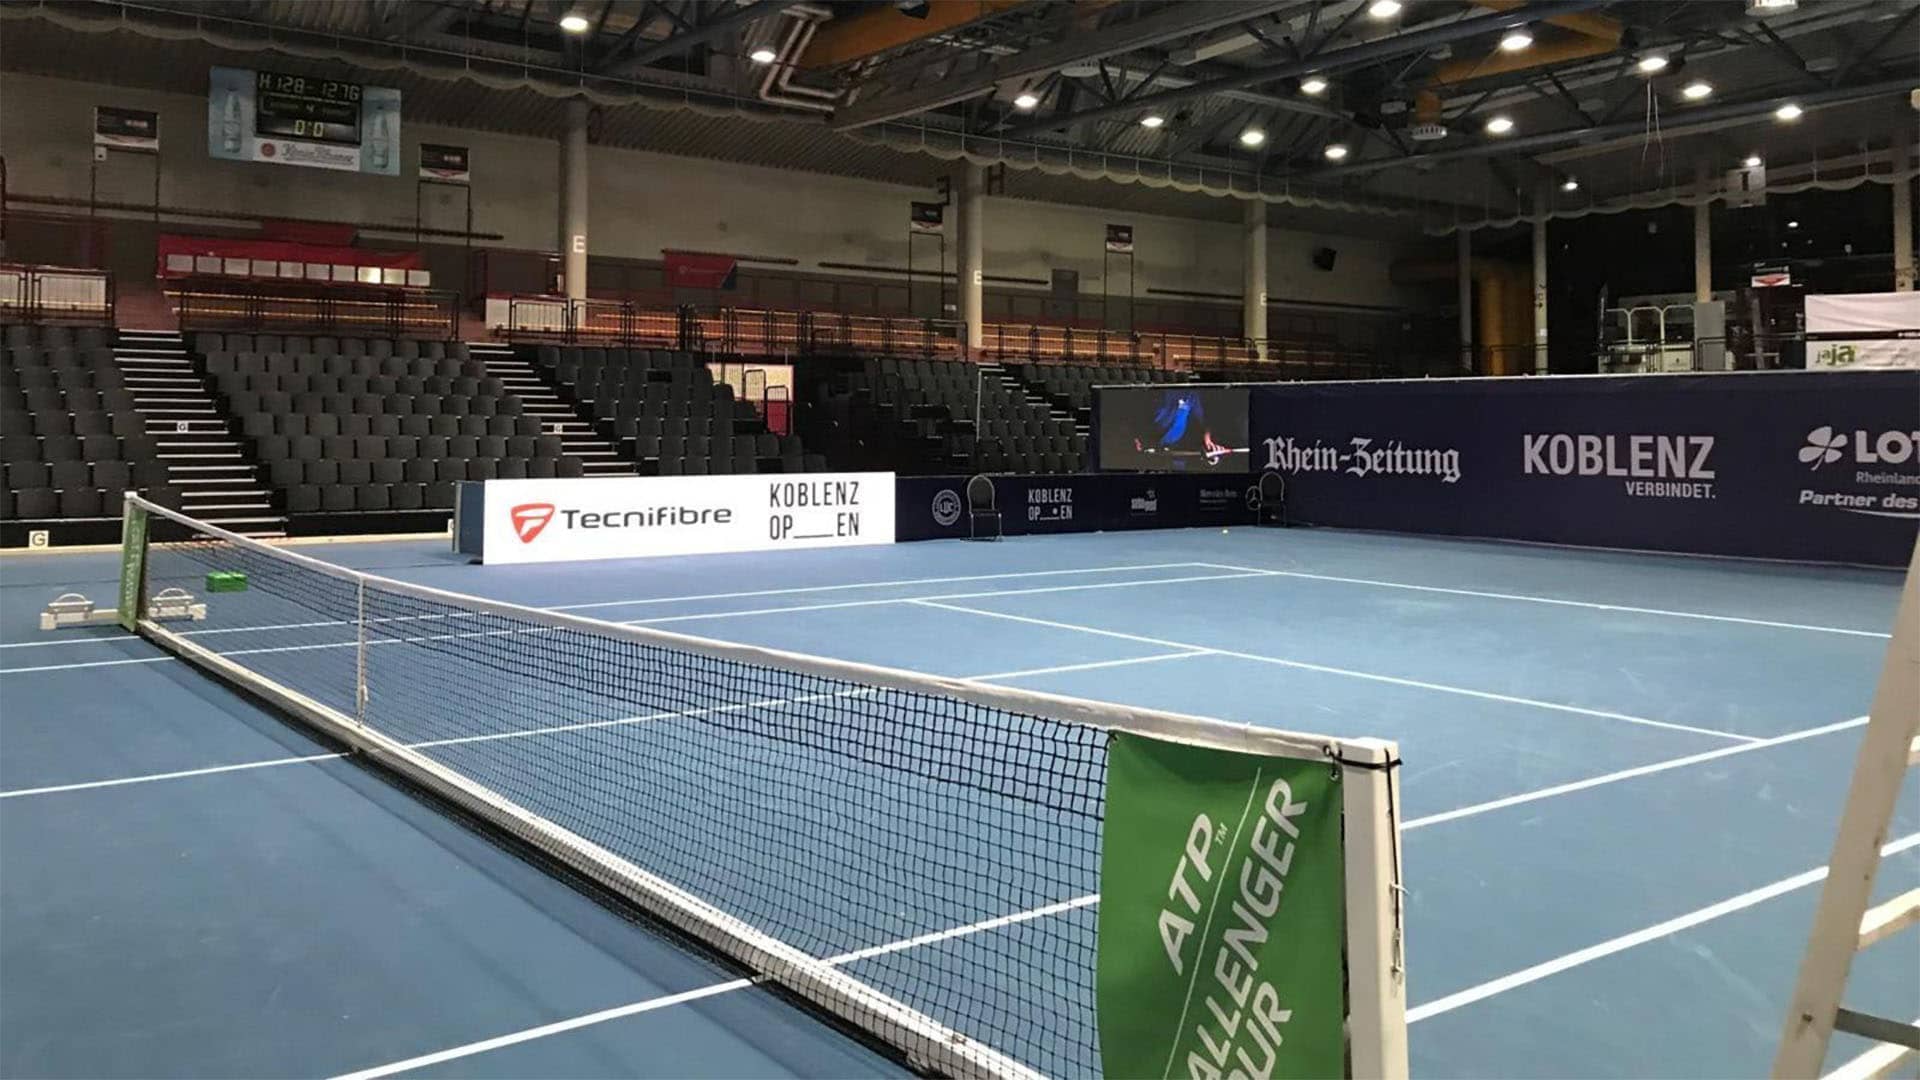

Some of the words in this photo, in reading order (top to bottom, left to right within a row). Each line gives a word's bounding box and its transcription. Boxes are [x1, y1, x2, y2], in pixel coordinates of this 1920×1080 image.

[573, 235, 586, 253] E
[1263, 435, 1461, 483] Rhein-Zeitung
[1523, 434, 1715, 479] KOBLENZ
[769, 481, 860, 508] KOBLENZ
[1028, 488, 1073, 503] KOBLENZ
[1625, 481, 1716, 499] VERBINDET.
[1799, 489, 1878, 507] Partner
[1882, 493, 1918, 509] des
[561, 506, 732, 530] Tecnifibre
[31, 532, 46, 546] G
[1158, 812, 1214, 977] ATP
[1227, 981, 1292, 1080] UR
